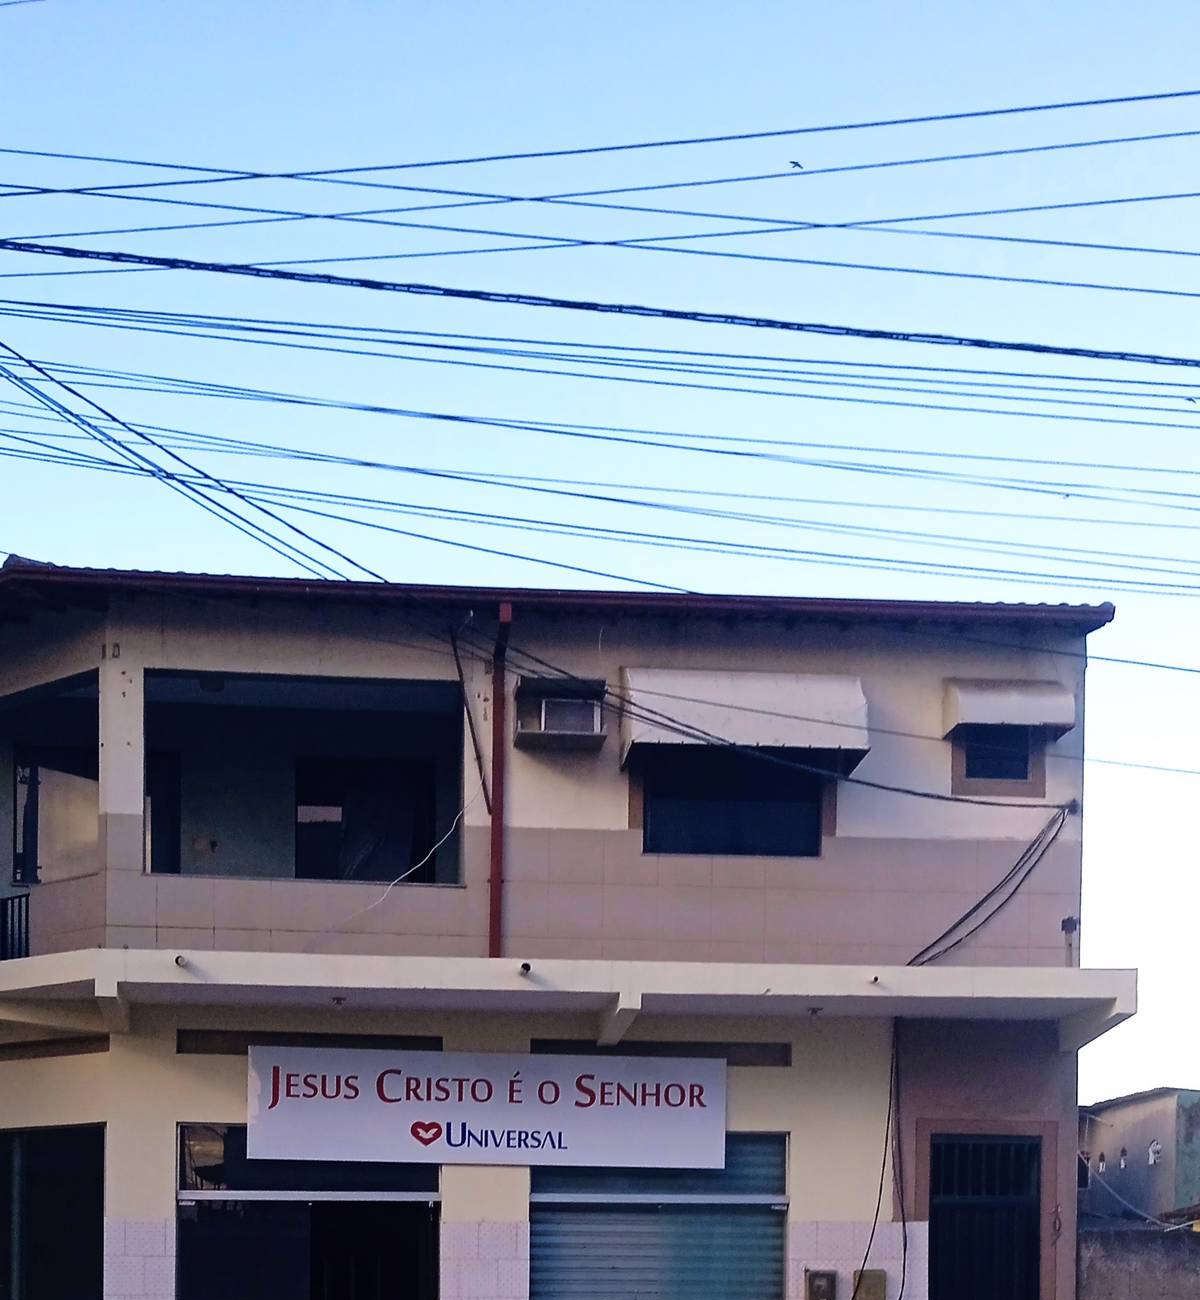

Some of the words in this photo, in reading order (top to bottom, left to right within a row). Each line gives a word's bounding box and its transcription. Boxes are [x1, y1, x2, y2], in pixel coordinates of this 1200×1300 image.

[268, 1065, 360, 1110] JESUS
[376, 1069, 494, 1104] CRISTO
[508, 1071, 523, 1104] É
[538, 1080, 560, 1105] O
[574, 1073, 707, 1109] SENHOR
[445, 1121, 568, 1150] UNIVERSAL
